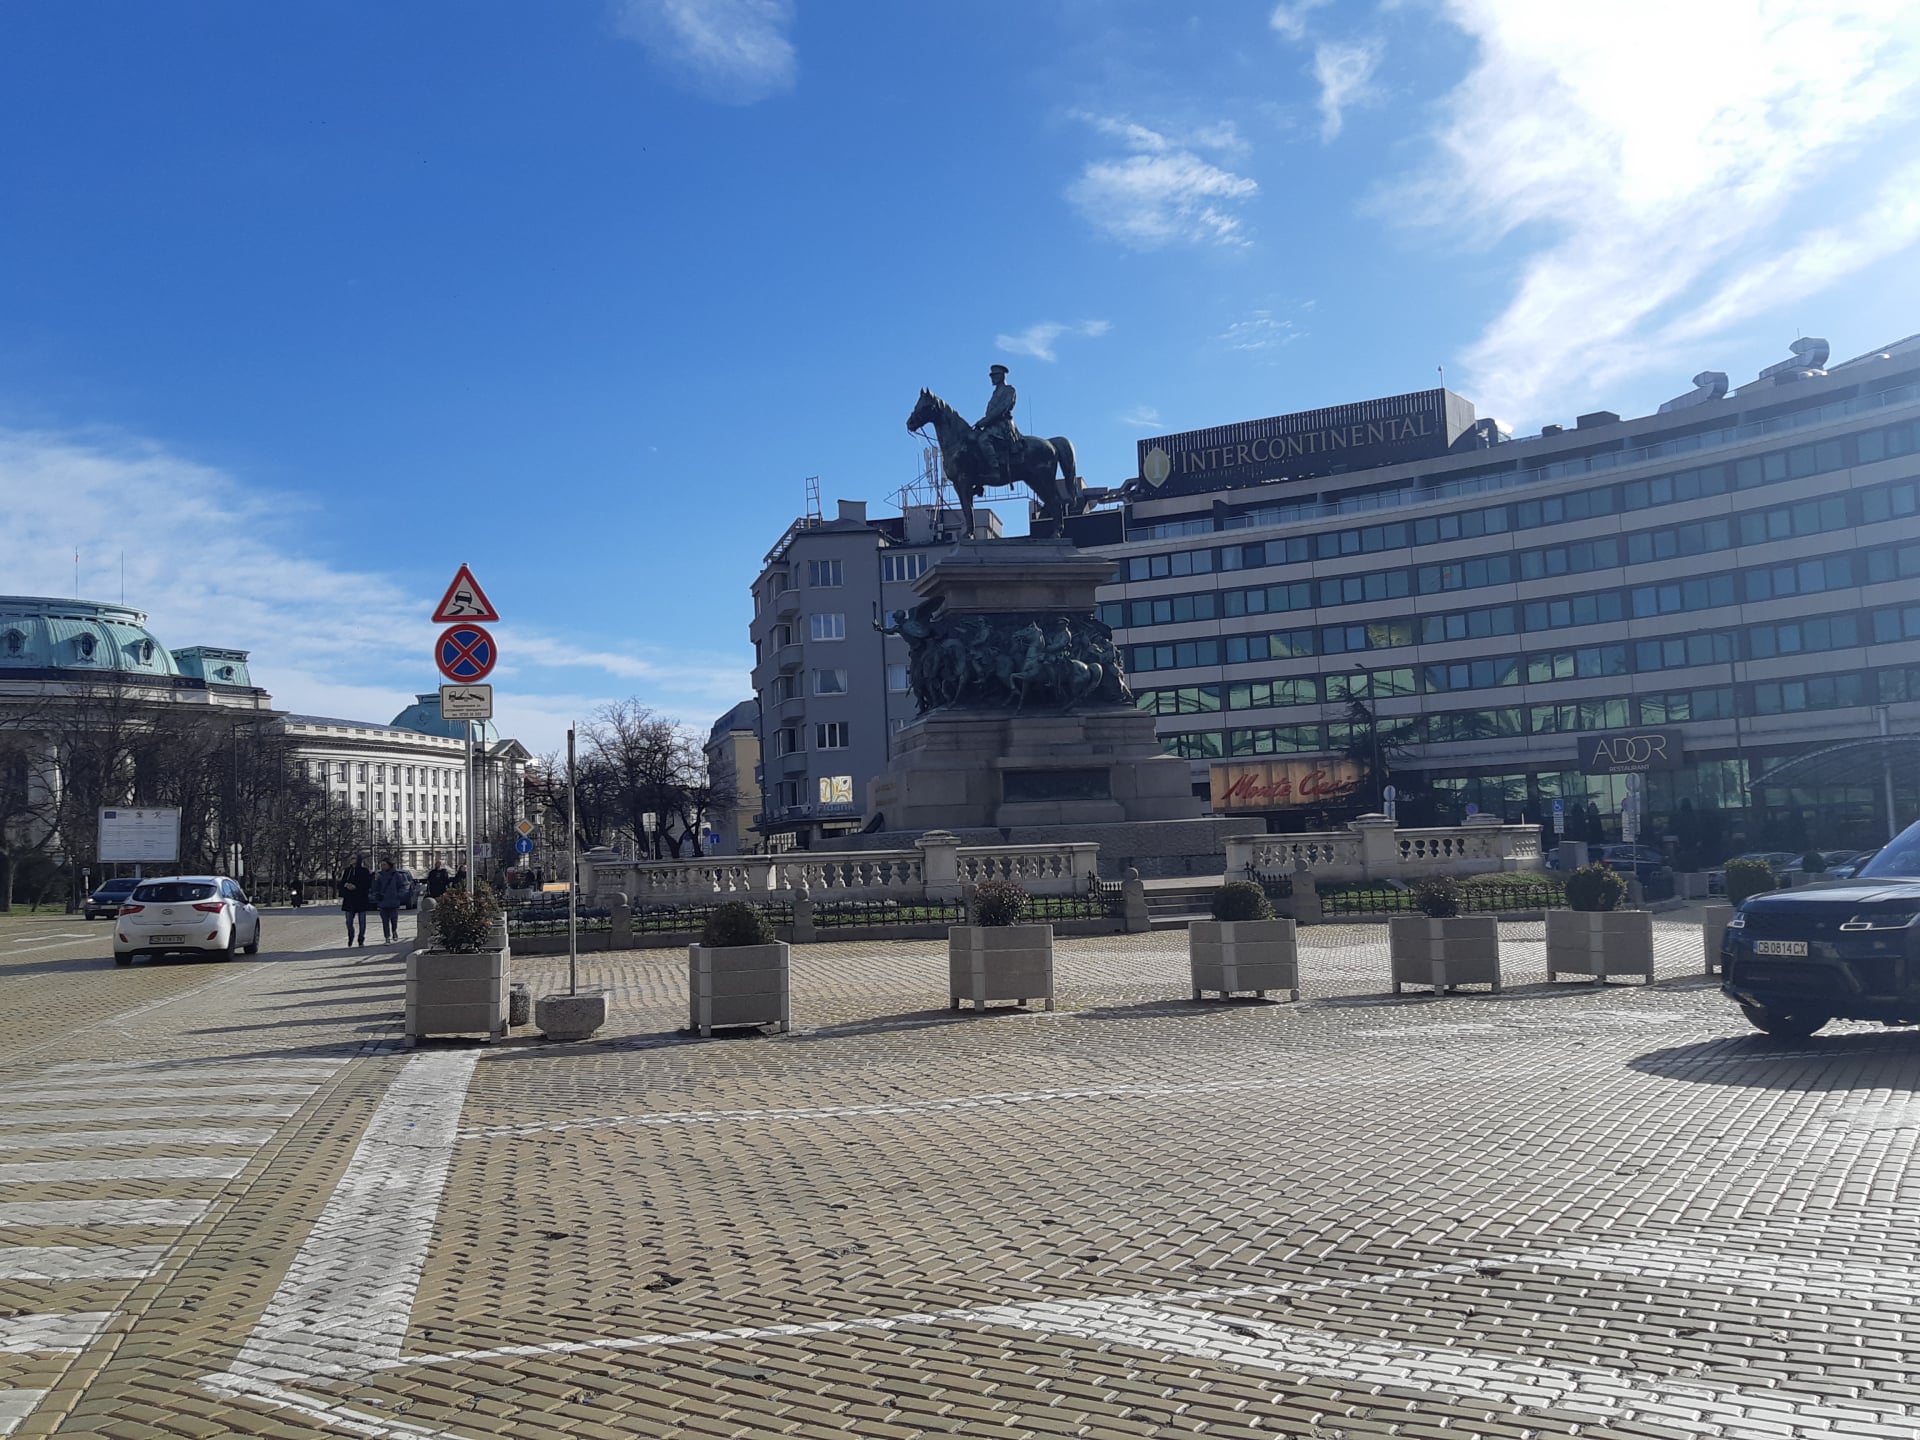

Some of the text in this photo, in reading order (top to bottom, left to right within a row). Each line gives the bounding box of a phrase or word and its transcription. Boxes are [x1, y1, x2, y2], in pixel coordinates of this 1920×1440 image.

[1181, 414, 1431, 474] INTERCONTINENTAL
[1592, 734, 1667, 765] ADOR
[1221, 773, 1292, 800] Monte
